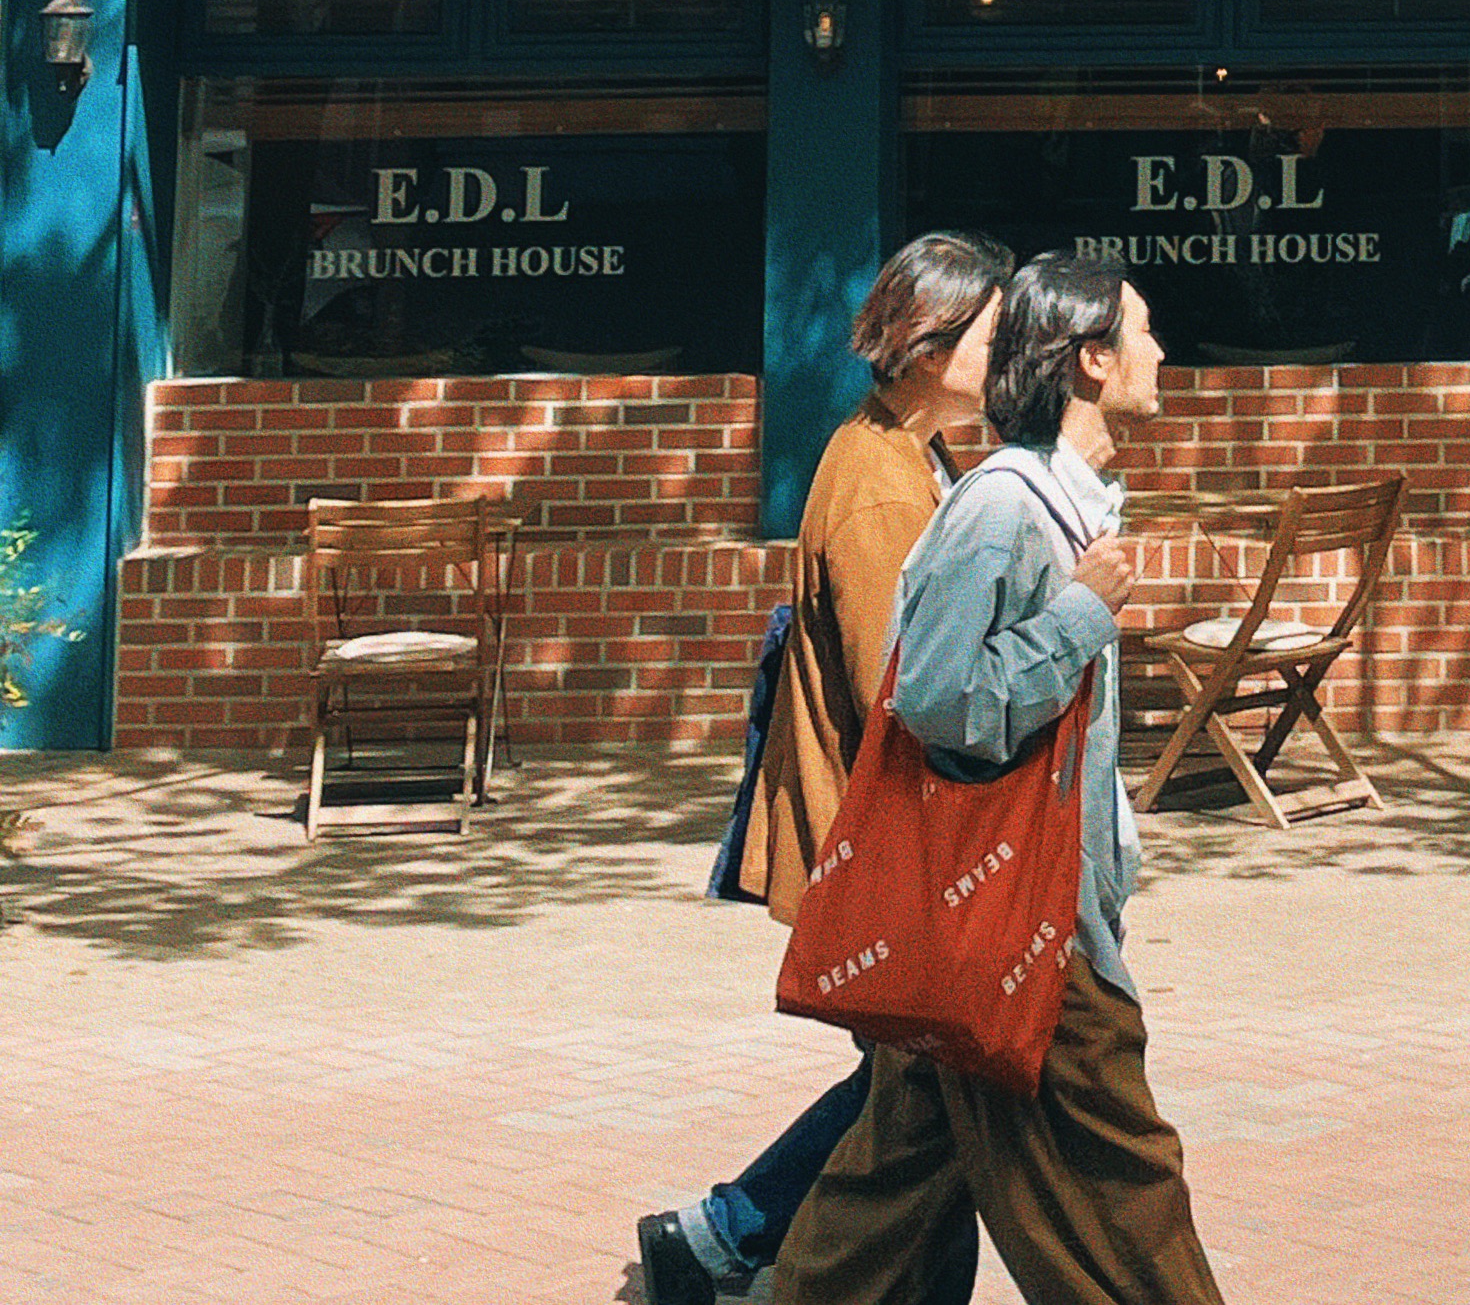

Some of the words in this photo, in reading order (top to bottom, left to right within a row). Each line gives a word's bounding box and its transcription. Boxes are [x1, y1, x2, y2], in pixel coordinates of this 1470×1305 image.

[370, 165, 569, 224] E.D.L
[1130, 154, 1324, 211] E.D.L
[310, 248, 479, 278] BRUNCH
[491, 246, 625, 276] HOUSE
[1074, 234, 1237, 264] BRUNCH
[1250, 233, 1381, 264] HOUSE
[943, 841, 1014, 908] BEAMS
[817, 940, 890, 995] BEAMS
